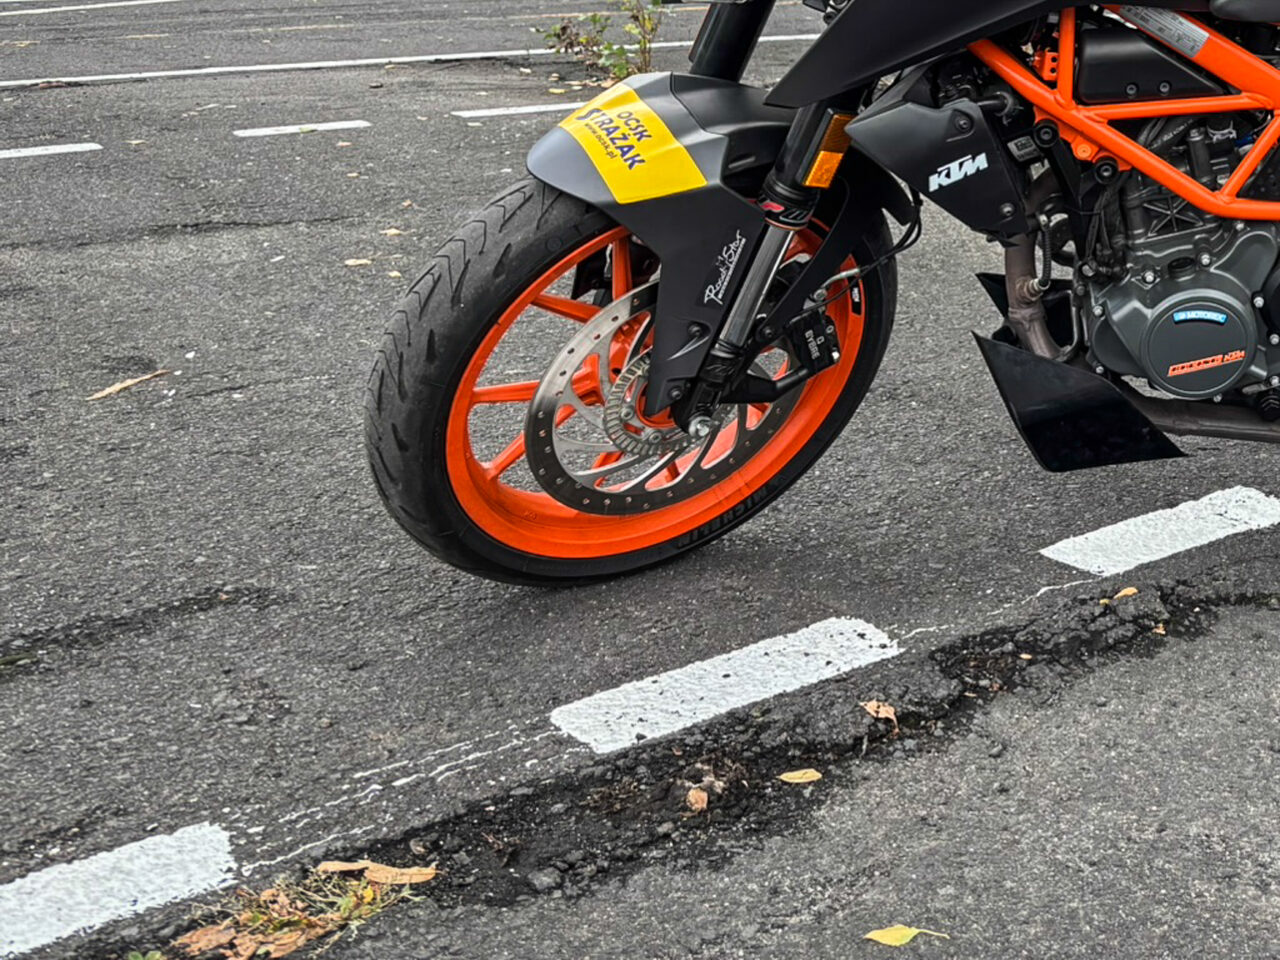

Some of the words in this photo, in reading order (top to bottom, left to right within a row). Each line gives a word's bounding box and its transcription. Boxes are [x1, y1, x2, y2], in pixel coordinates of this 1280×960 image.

[576, 108, 645, 170] STRAŻAK
[584, 123, 617, 160] www.ocsk.pl
[617, 111, 652, 142] OCSK
[928, 152, 988, 192] KTM
